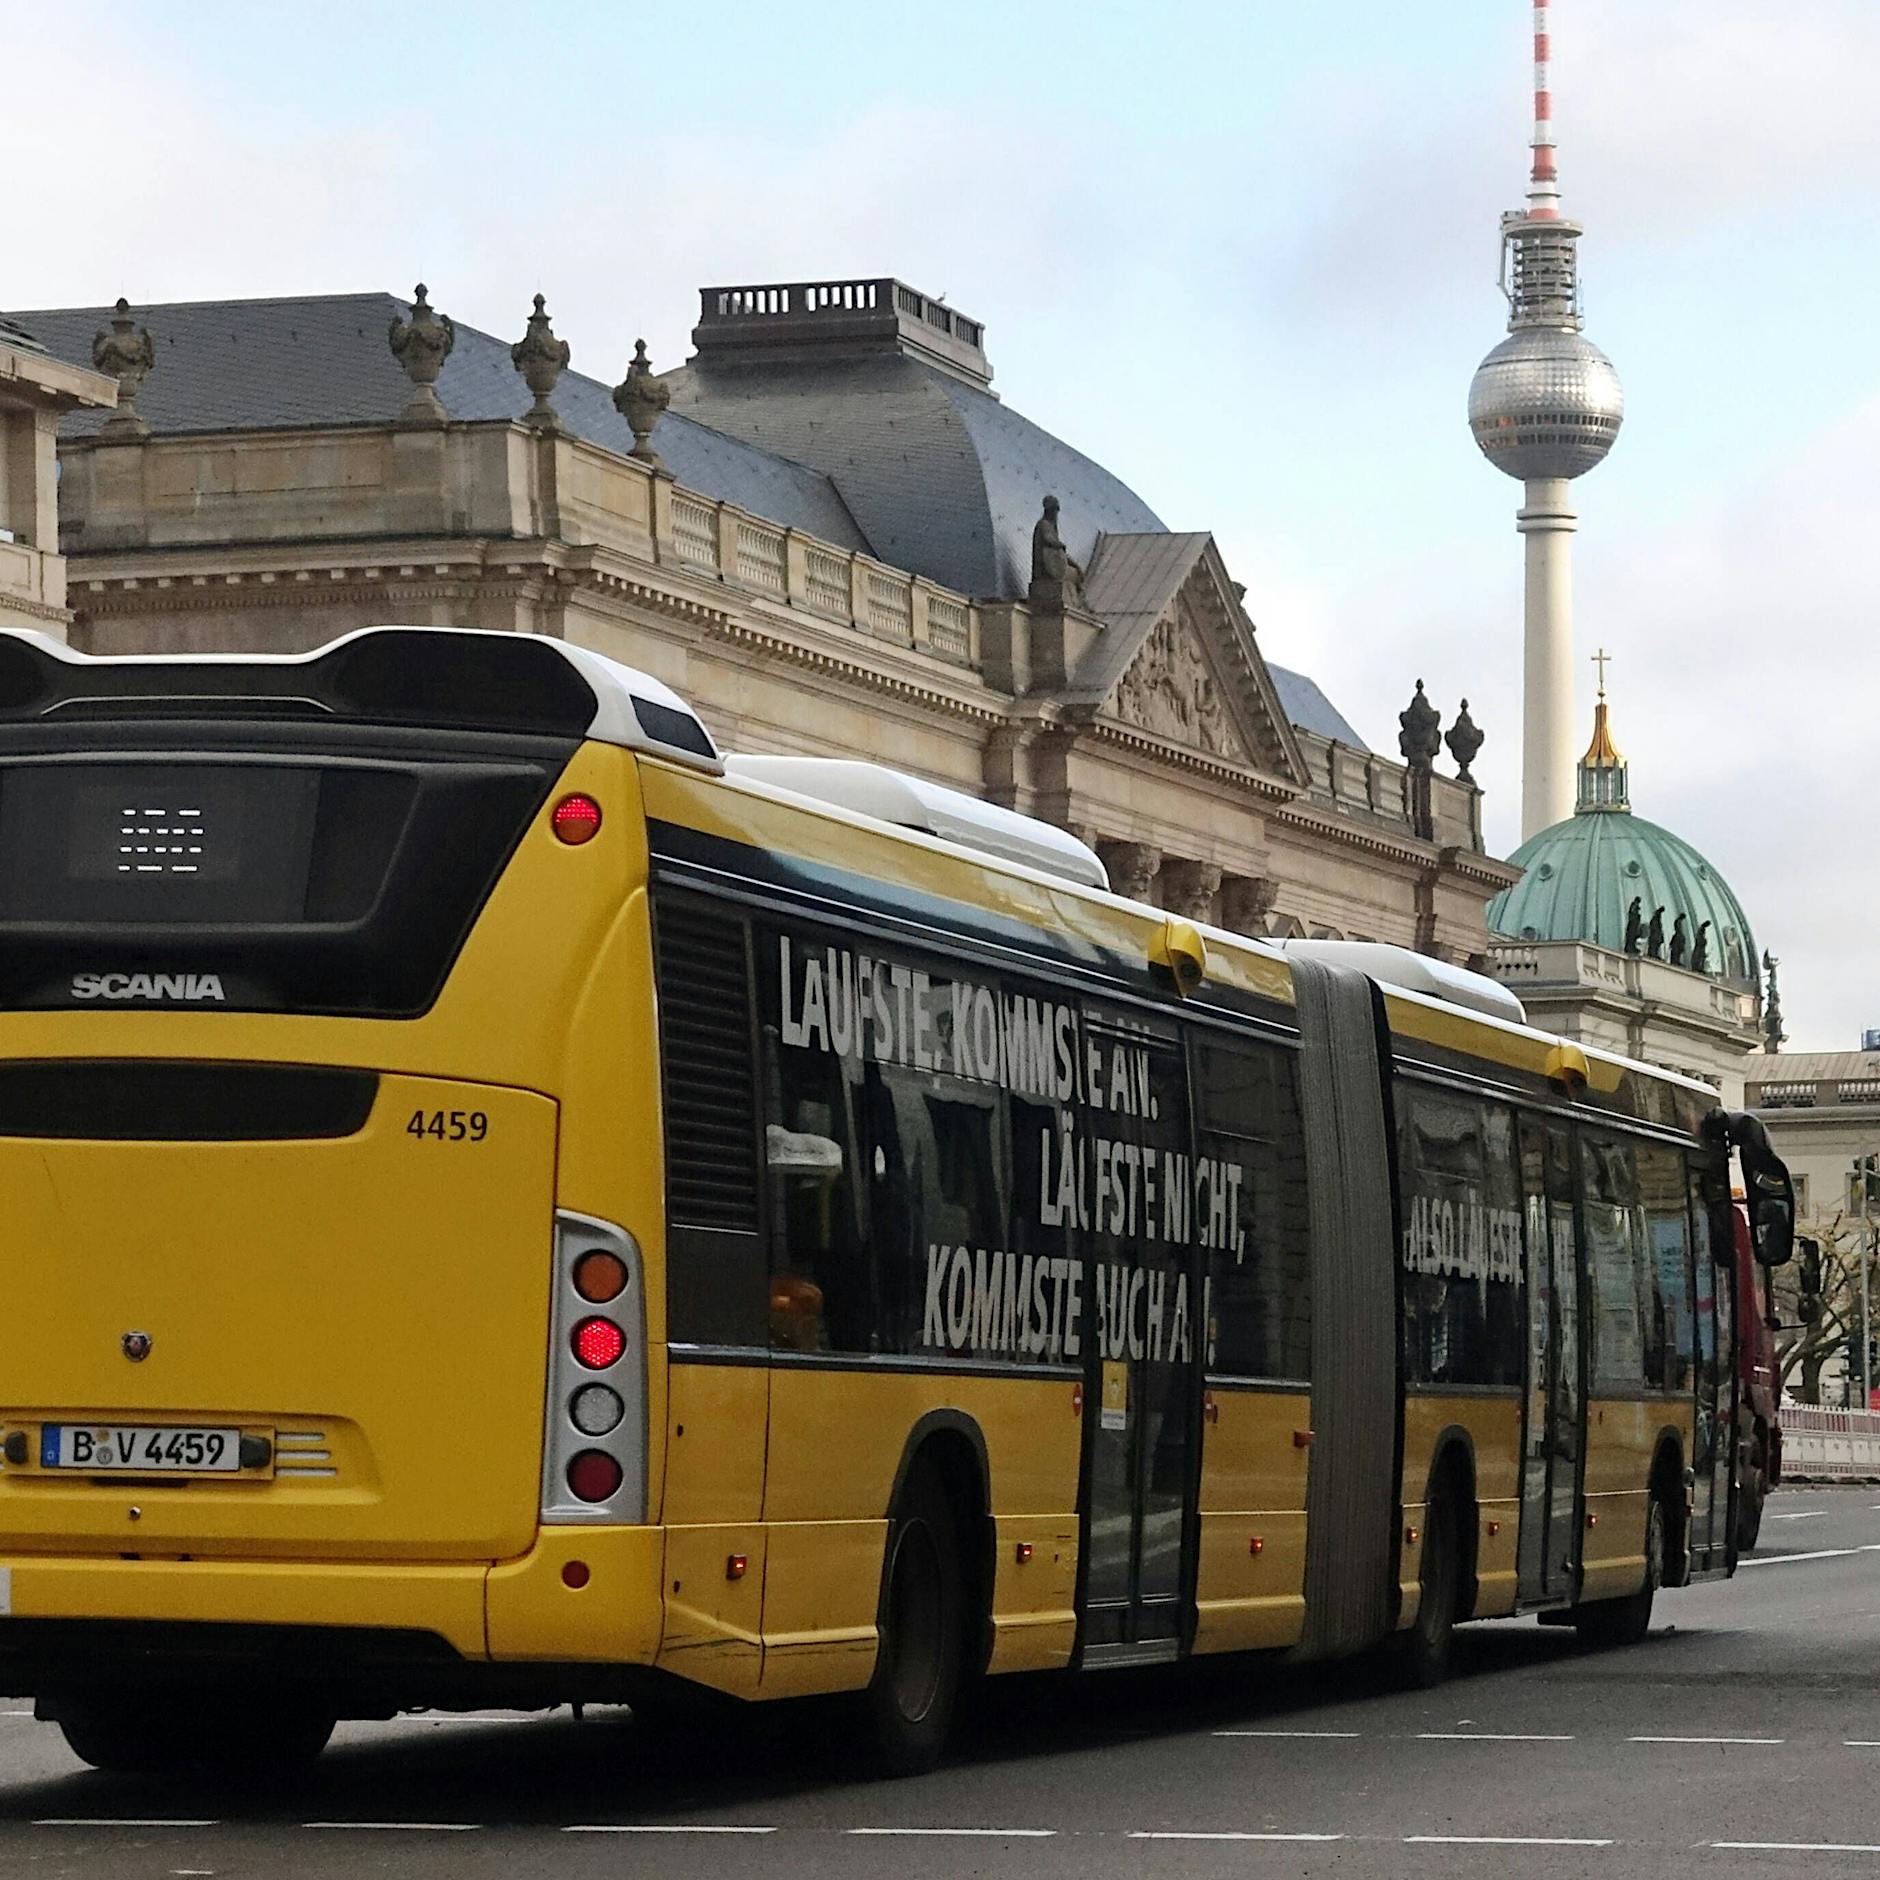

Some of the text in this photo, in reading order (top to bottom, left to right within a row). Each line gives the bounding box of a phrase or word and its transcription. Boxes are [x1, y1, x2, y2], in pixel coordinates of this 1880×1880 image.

[71, 972, 225, 1001] SCANIA
[406, 1110, 488, 1141] 4459
[922, 1244, 1084, 1356] KOMMSTE
[73, 1431, 225, 1466] B V 4459
